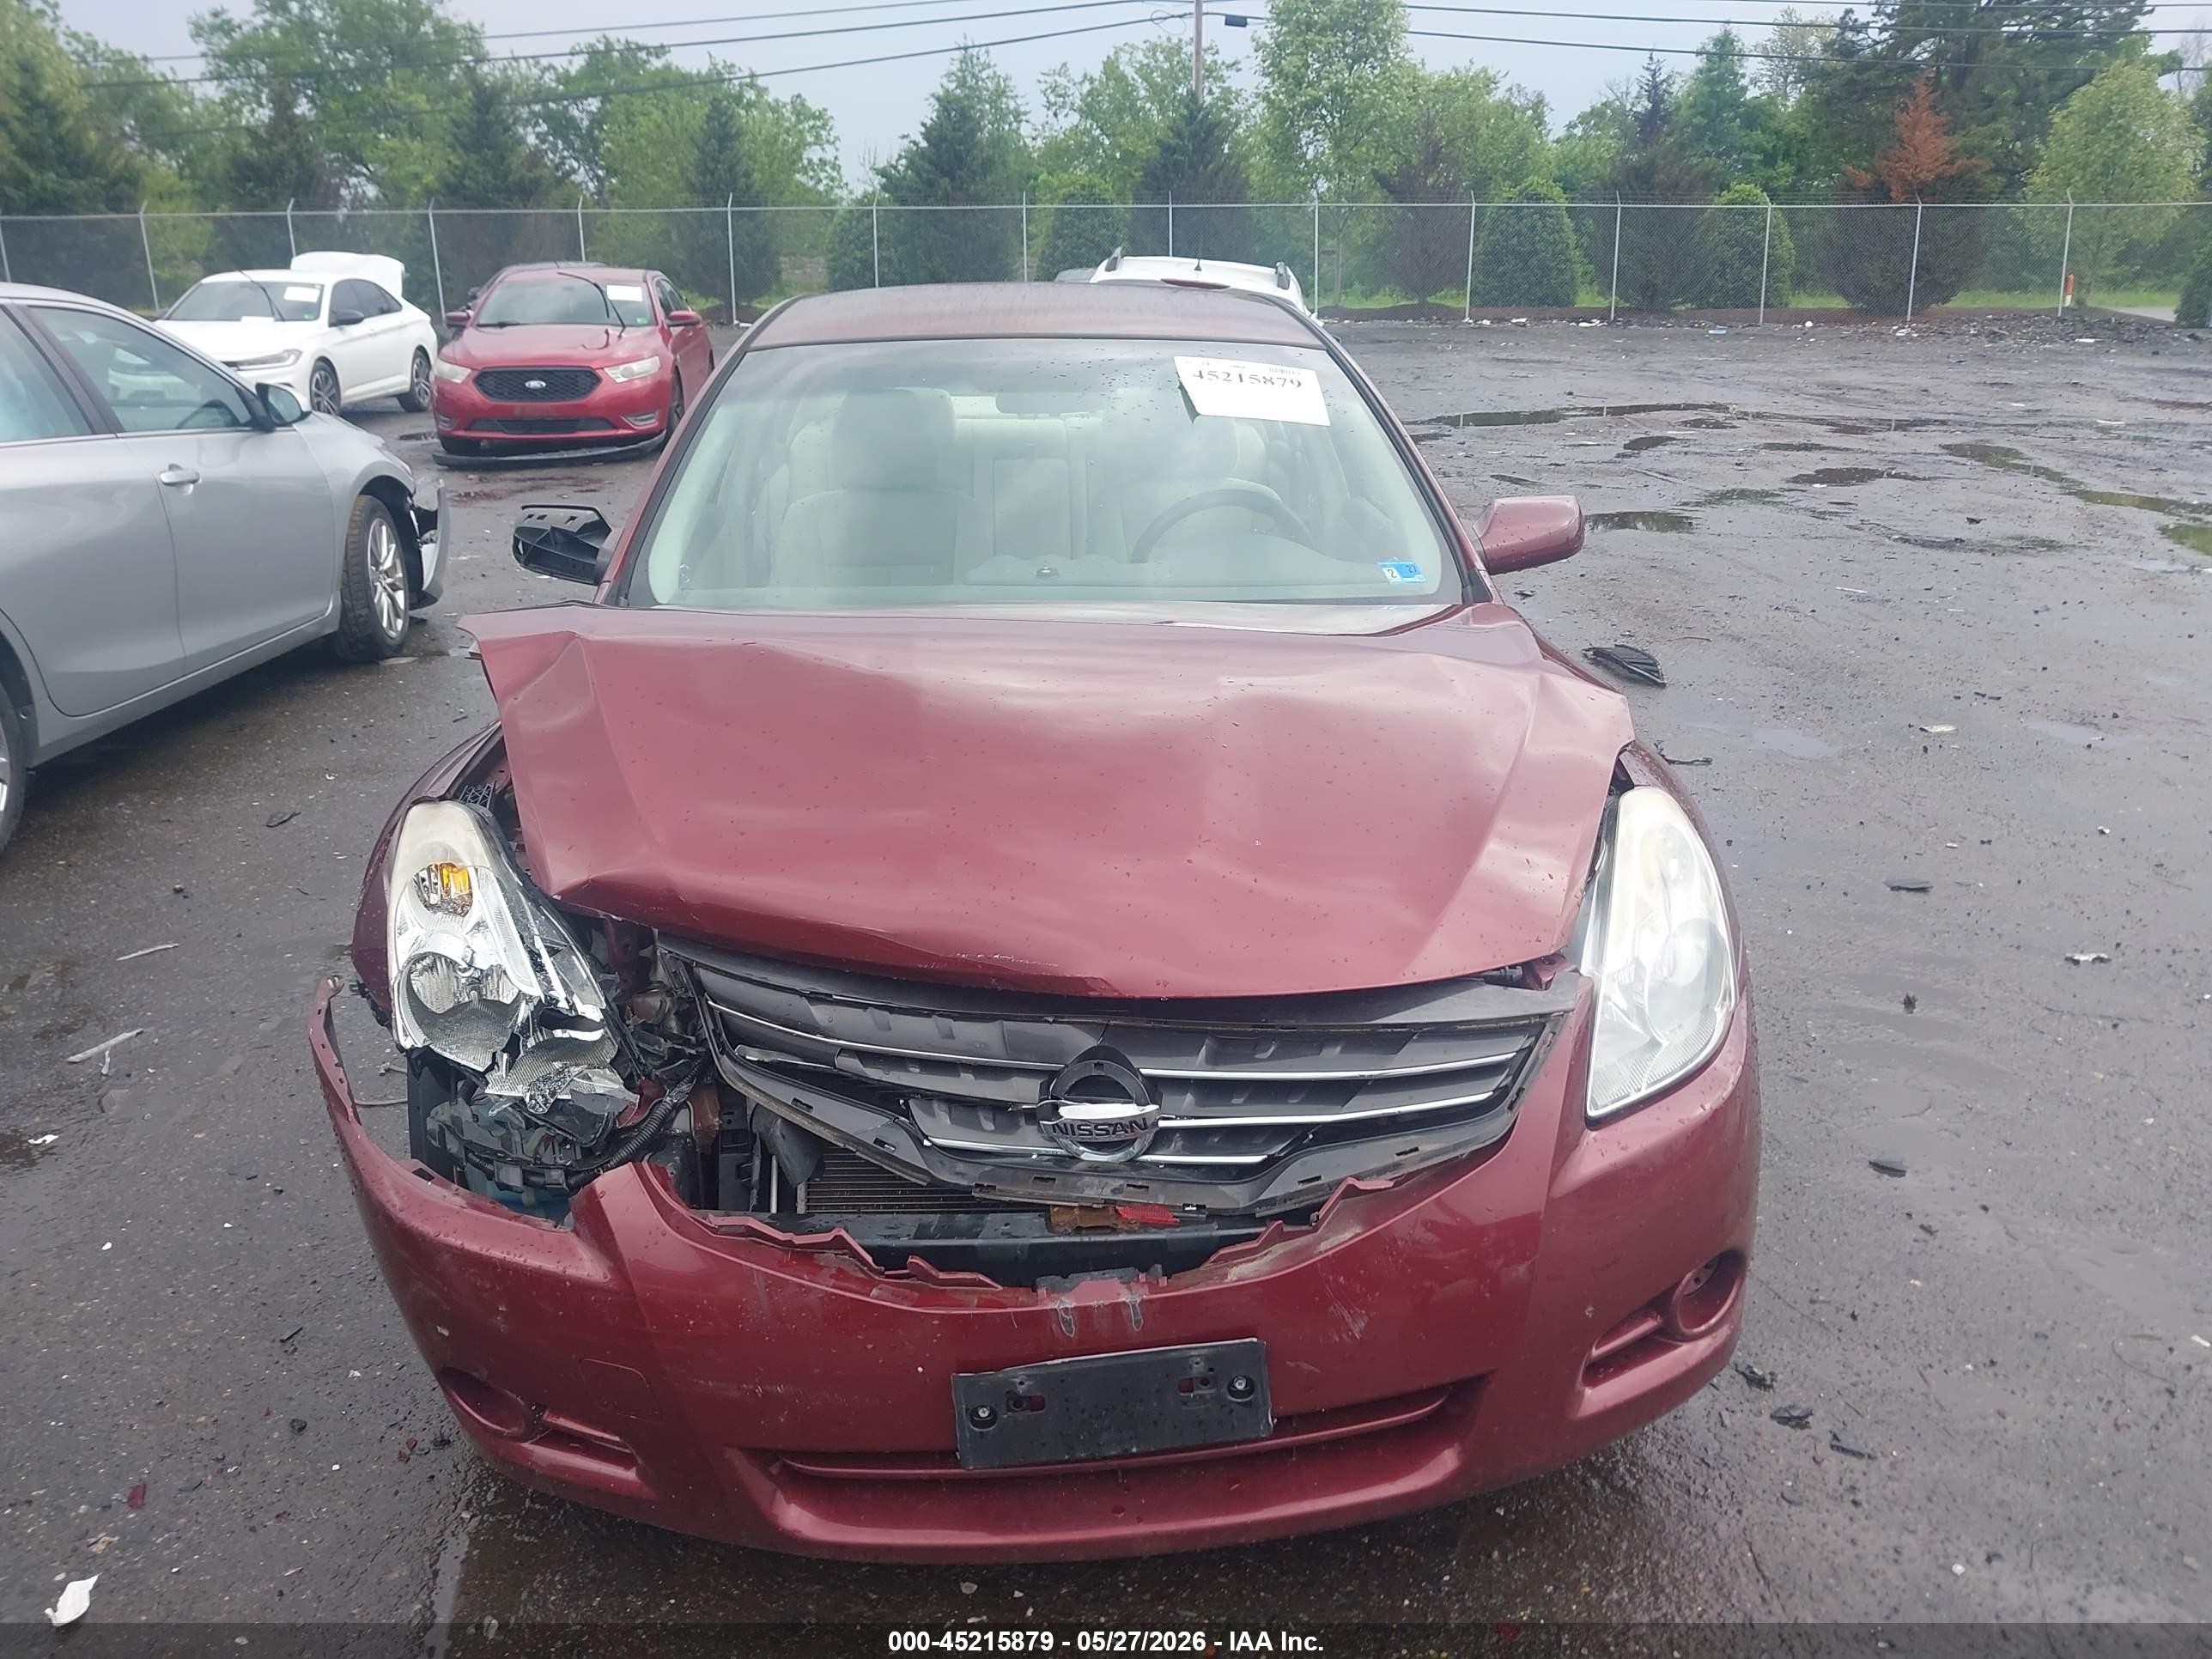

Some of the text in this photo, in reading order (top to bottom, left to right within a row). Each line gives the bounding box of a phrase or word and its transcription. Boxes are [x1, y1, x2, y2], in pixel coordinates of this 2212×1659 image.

[1192, 369, 1303, 389] 45215879
[1387, 568, 1398, 579] 2
[1051, 1117, 1149, 1138] NISSAN
